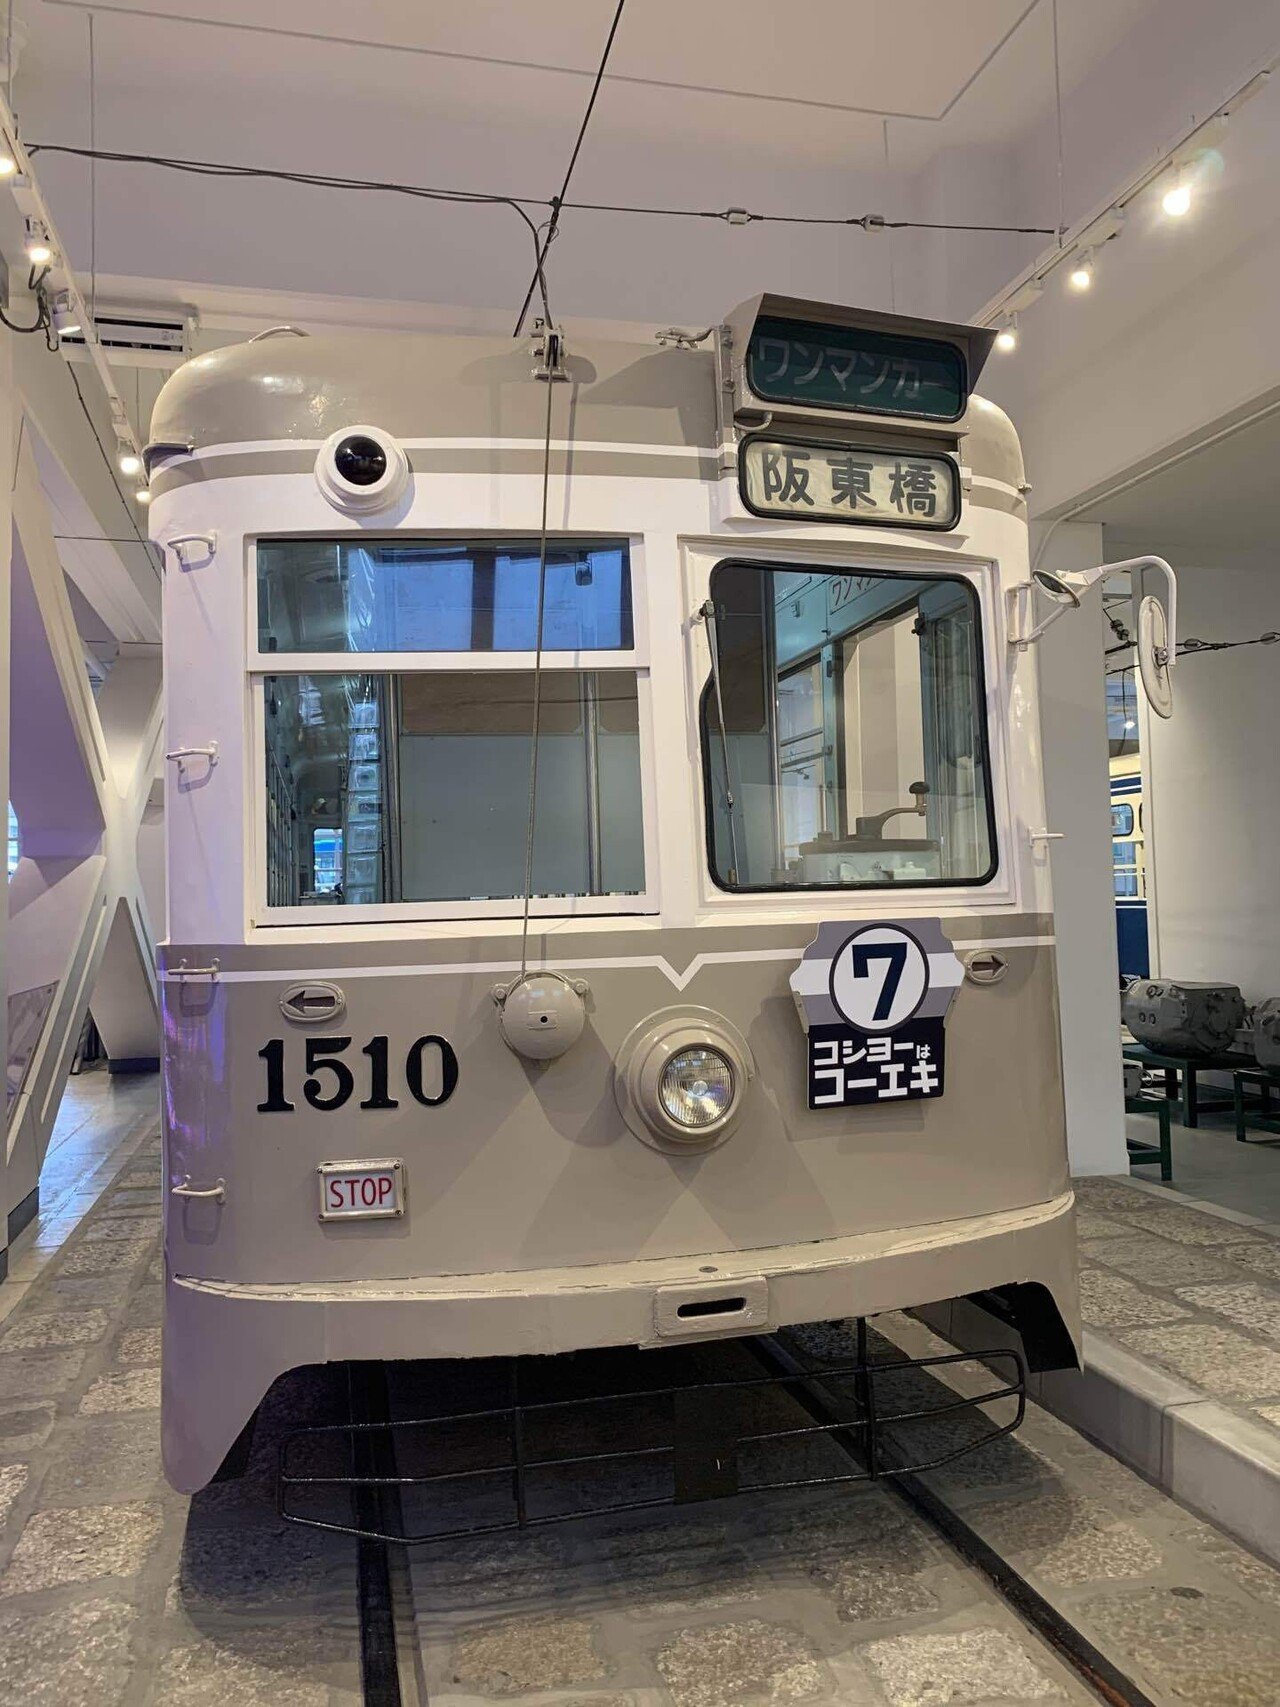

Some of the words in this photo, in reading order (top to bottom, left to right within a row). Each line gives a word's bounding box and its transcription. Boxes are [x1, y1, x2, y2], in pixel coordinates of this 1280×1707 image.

[761, 450, 937, 517] 阪東橋
[852, 942, 908, 1021] 7
[257, 1034, 459, 1112] 1510
[813, 1060, 939, 1105] コーエキ
[329, 1177, 393, 1209] STOP
